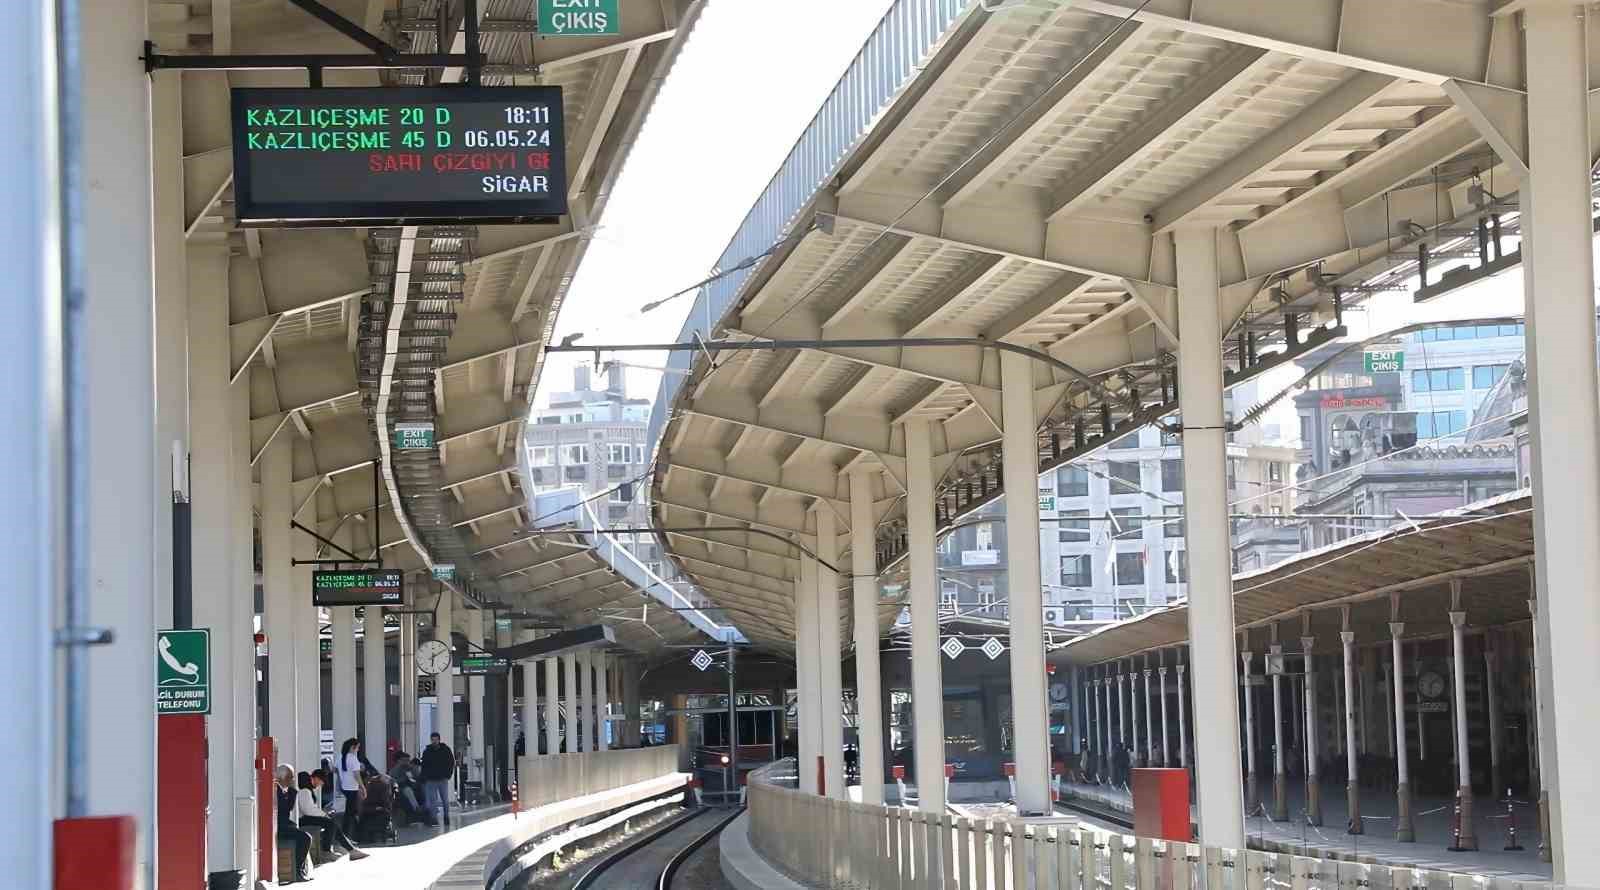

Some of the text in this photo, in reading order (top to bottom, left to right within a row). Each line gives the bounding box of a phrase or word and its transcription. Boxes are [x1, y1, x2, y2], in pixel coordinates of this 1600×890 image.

[552, 12, 608, 32] ÇIKIŞ
[247, 107, 550, 129] KAZLIÇEŞME 20 D 18:11
[248, 130, 550, 151] KAZLIÇEŞME 45 D 06.05.24
[1372, 351, 1396, 360] EXIT
[175, 690, 205, 698] DURUM
[155, 700, 201, 709] TELEFONU
